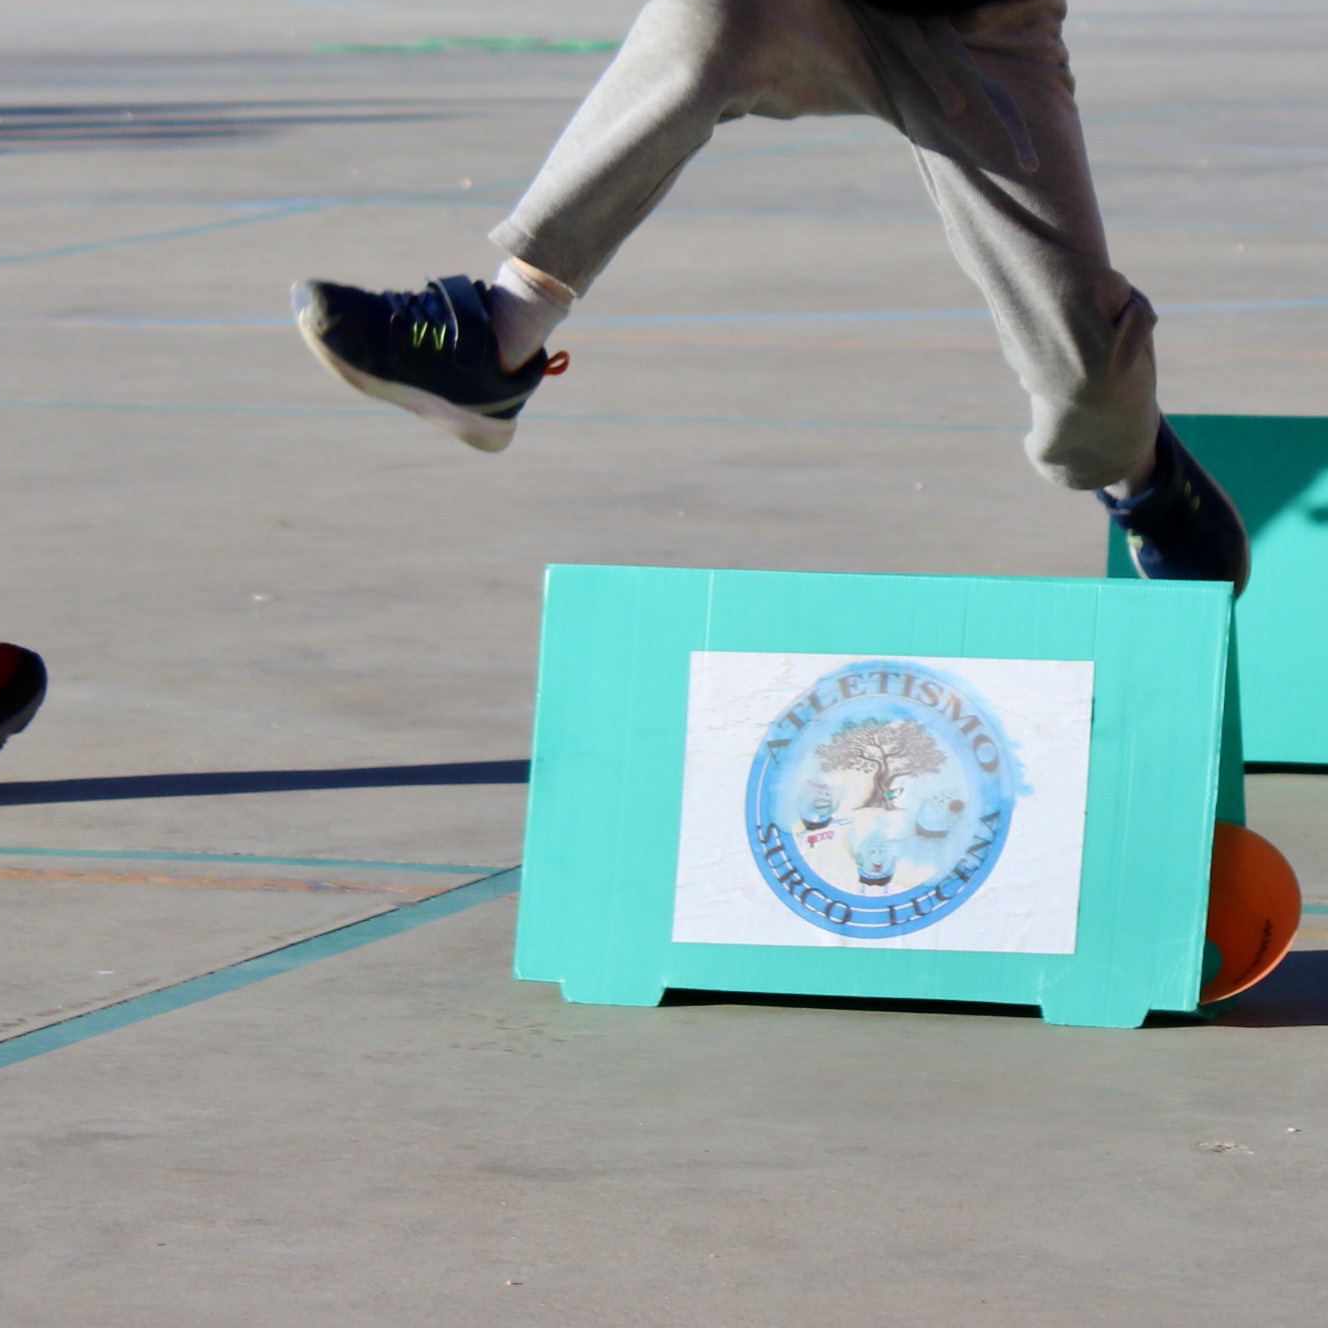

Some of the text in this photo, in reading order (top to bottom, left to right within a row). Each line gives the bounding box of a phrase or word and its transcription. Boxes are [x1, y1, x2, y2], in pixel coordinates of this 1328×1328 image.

[767, 669, 1000, 773] ATLETISMO
[757, 810, 1001, 926] SURCO LUCENA
